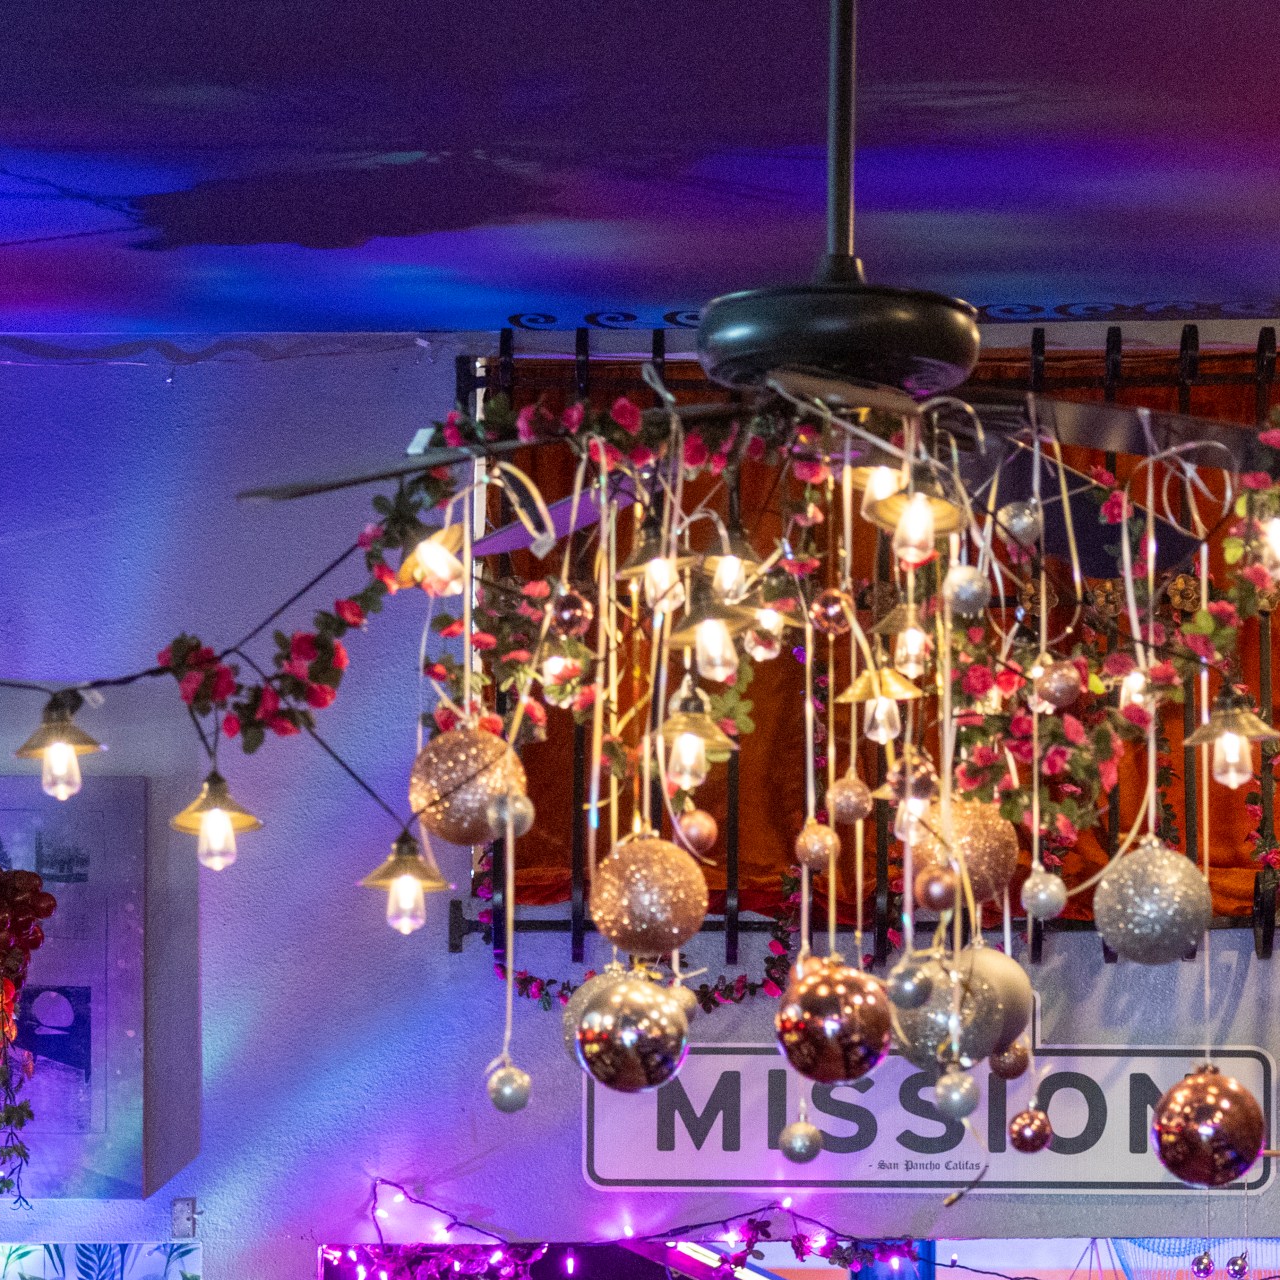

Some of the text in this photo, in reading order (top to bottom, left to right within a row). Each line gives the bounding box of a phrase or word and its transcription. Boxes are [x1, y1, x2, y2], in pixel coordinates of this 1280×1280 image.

[877, 1160, 899, 1170] San
[904, 1160, 941, 1171] Pancho
[944, 1160, 981, 1170] Califas
